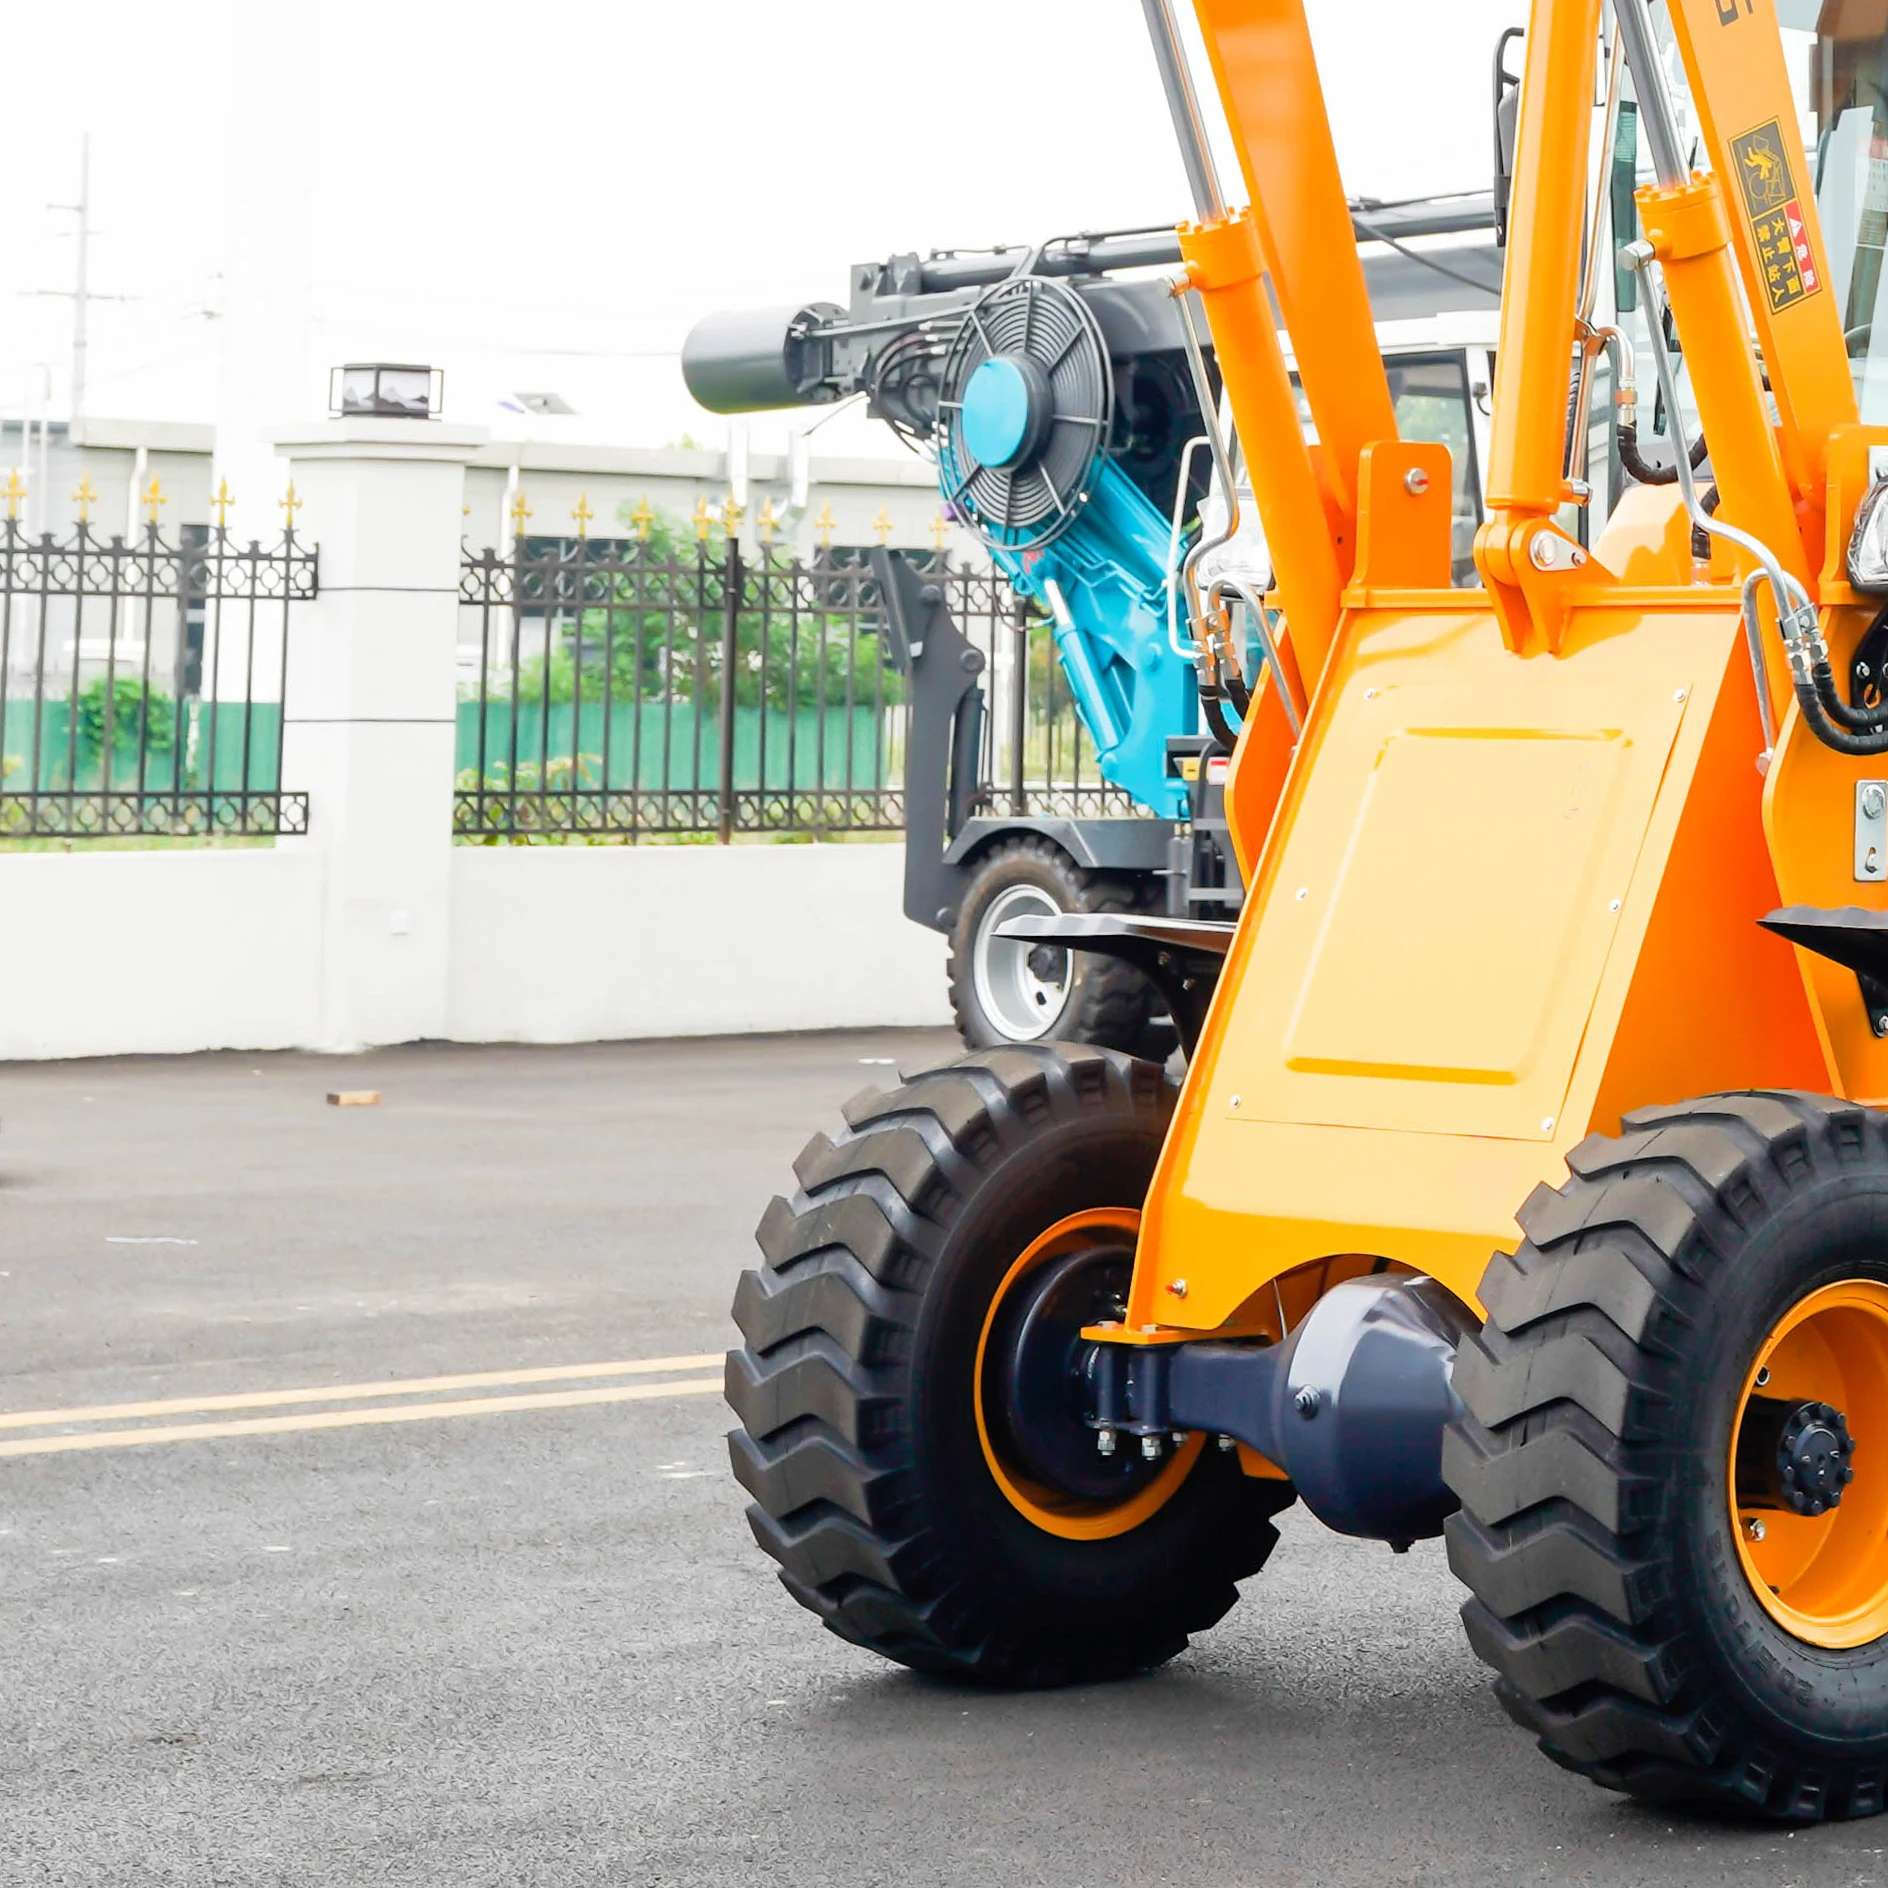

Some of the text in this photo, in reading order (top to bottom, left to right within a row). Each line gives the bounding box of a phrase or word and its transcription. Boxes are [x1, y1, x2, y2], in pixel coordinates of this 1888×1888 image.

[1756, 224, 1785, 303] 禁止站人
[1771, 217, 1801, 295] 大臂下面
[1796, 243, 1816, 288] 危险
